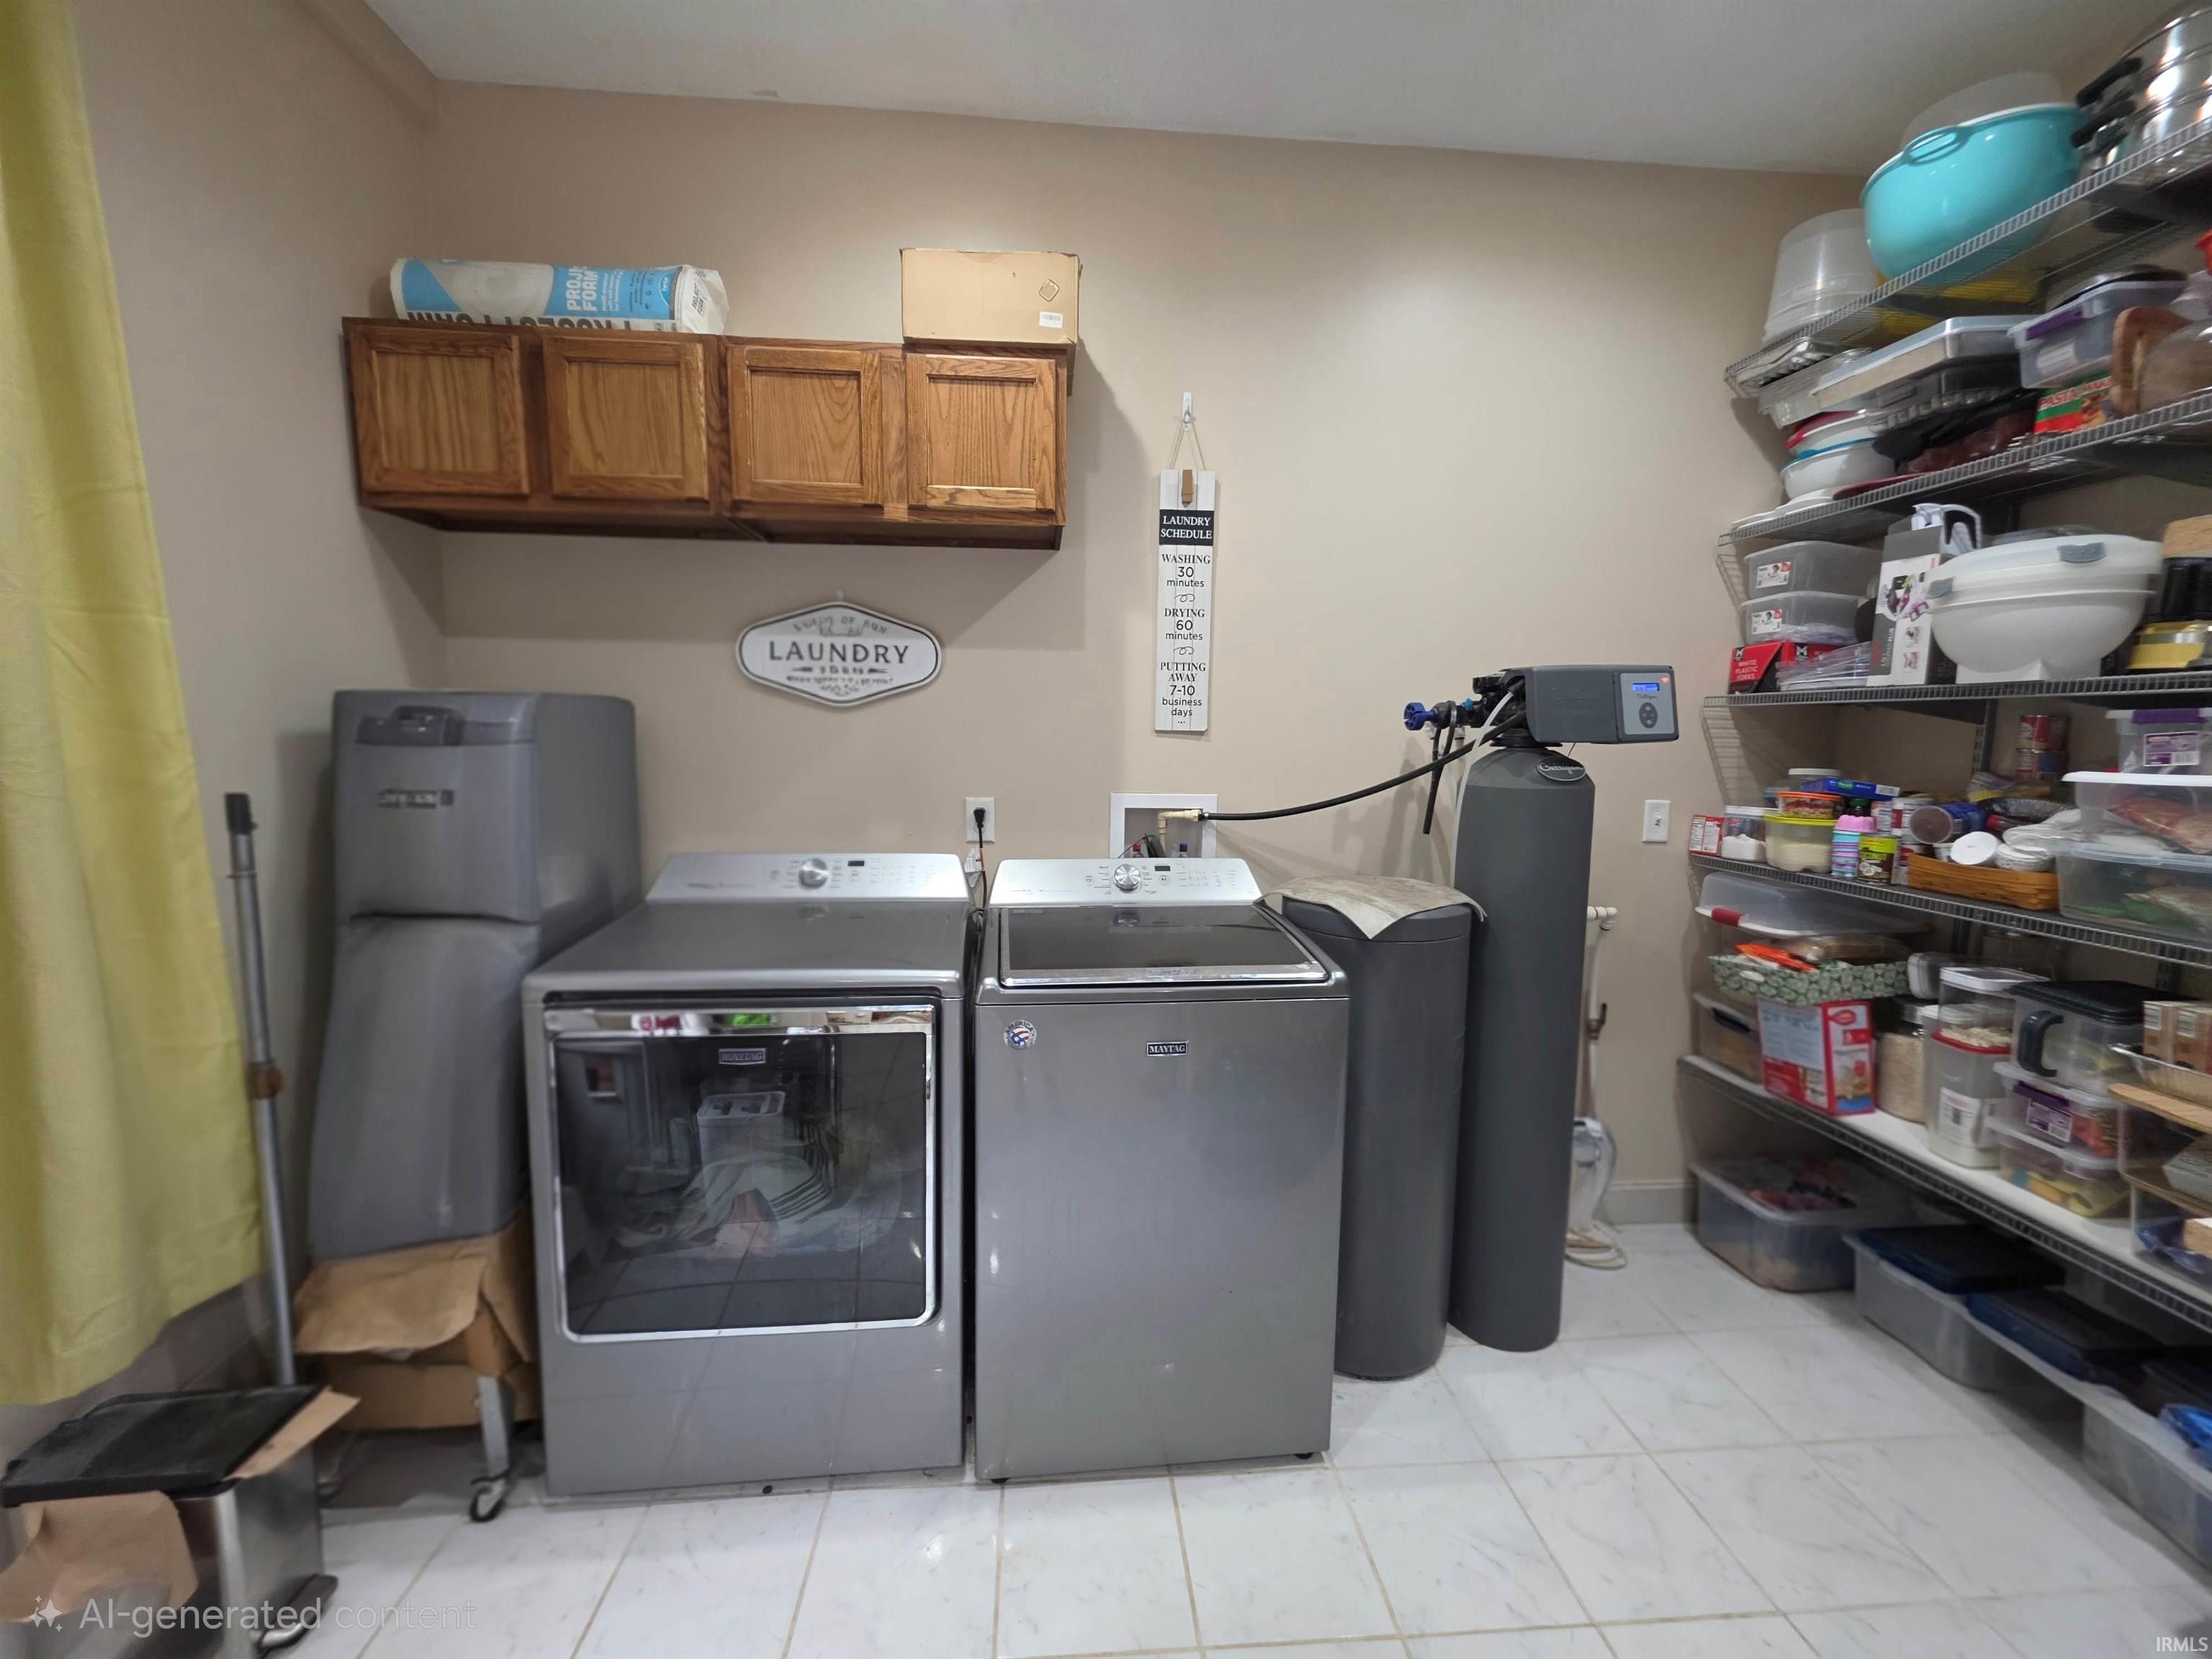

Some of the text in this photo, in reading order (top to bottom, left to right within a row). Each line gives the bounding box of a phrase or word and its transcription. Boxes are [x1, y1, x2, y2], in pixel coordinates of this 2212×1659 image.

[1163, 516, 1211, 526] LAUNDRY
[1160, 529, 1212, 539] SCHEDULE
[1161, 554, 1210, 564] WASHING
[1177, 567, 1194, 577] 30
[1166, 578, 1204, 587] minutes
[1164, 608, 1205, 618] DRYING
[1176, 620, 1193, 631] 60
[1165, 631, 1203, 640] minutes
[769, 640, 909, 664] LAUNDRY
[1160, 662, 1206, 672] PUTTING
[1169, 673, 1197, 682] AWAY
[1169, 685, 1195, 696] 7-10
[1161, 697, 1202, 706] business
[1171, 708, 1193, 717] days
[1148, 1044, 1186, 1053] MAYTAG
[721, 1052, 763, 1061] MAYTAG
